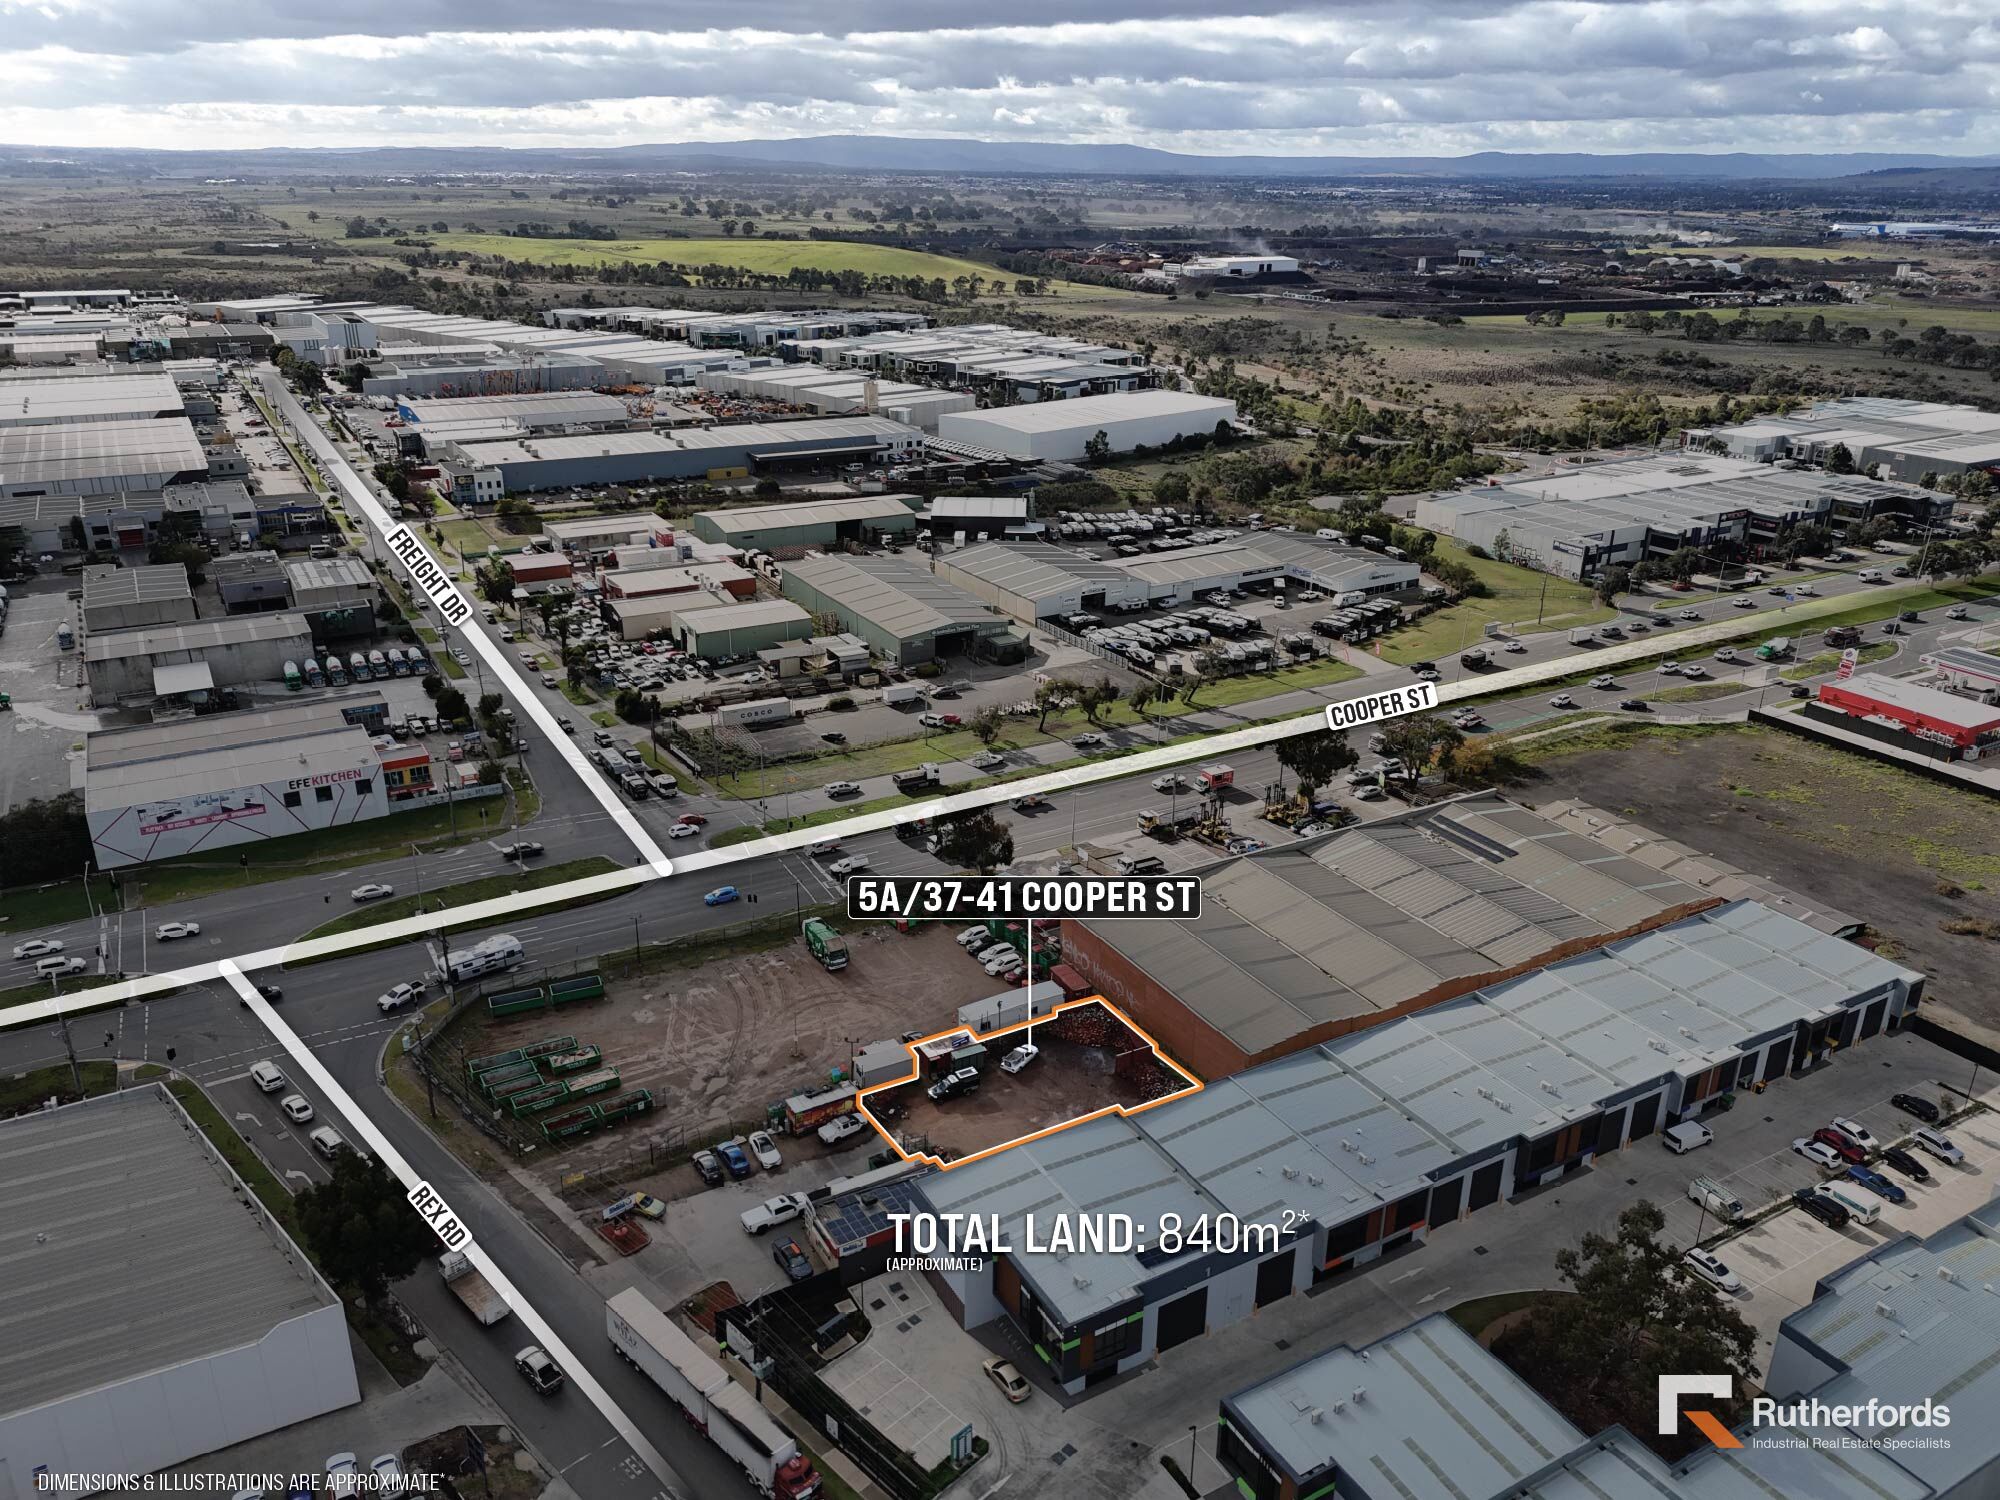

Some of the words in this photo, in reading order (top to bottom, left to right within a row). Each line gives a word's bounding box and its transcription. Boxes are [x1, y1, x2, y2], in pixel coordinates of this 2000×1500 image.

[740, 709, 773, 719] COSCO
[288, 778, 311, 790] EFE
[311, 768, 362, 787] KITCHEN
